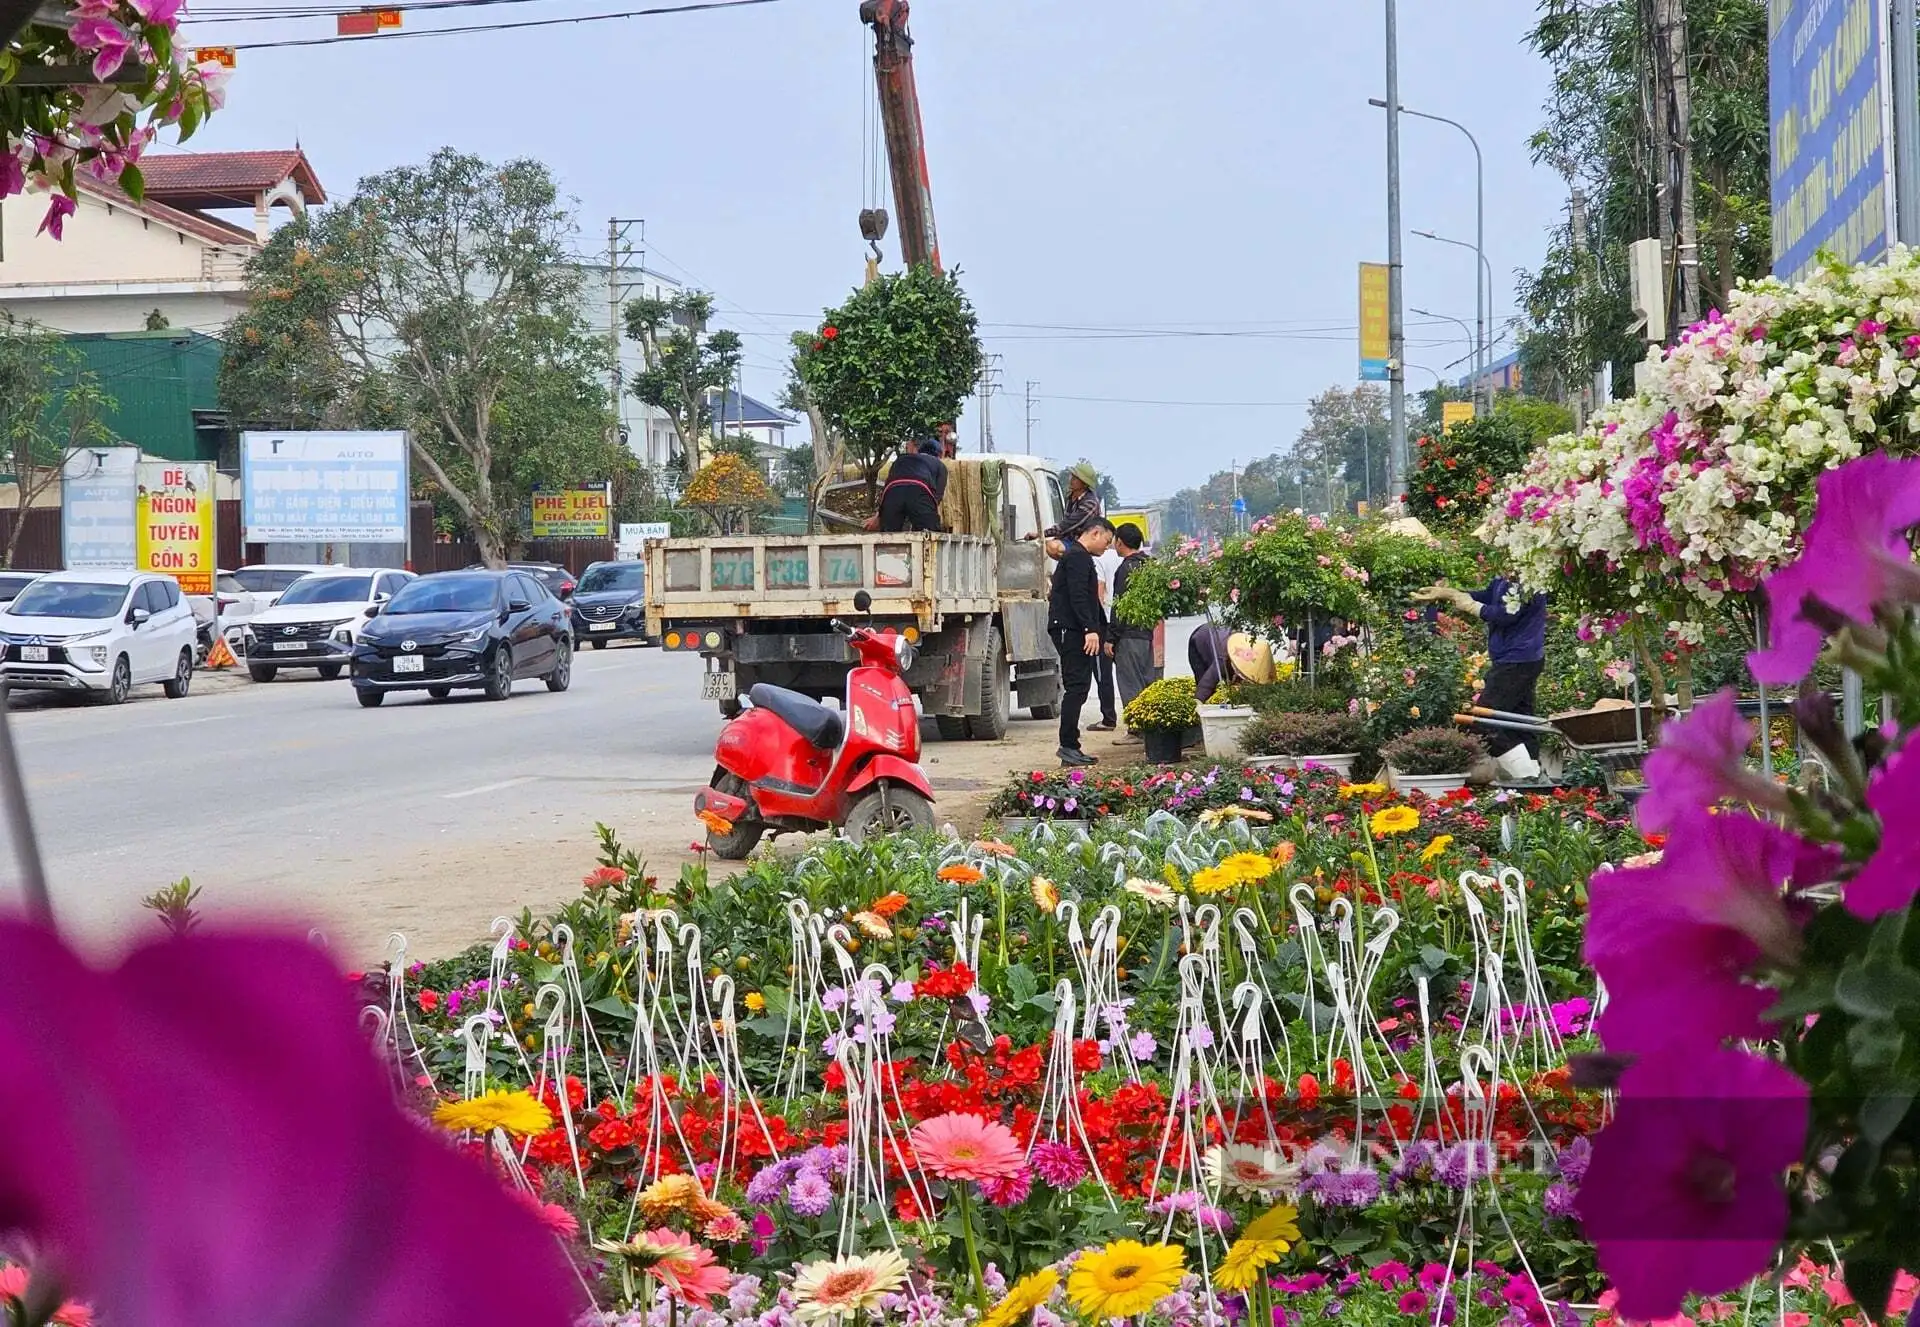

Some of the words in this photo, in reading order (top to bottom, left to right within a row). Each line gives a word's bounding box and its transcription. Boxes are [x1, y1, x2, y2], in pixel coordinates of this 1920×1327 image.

[164, 467, 183, 486] DÊ
[151, 498, 196, 513] NGON
[573, 512, 602, 521] CAO
[189, 553, 199, 568] 3
[828, 558, 858, 583] 74
[711, 673, 728, 686] 37C
